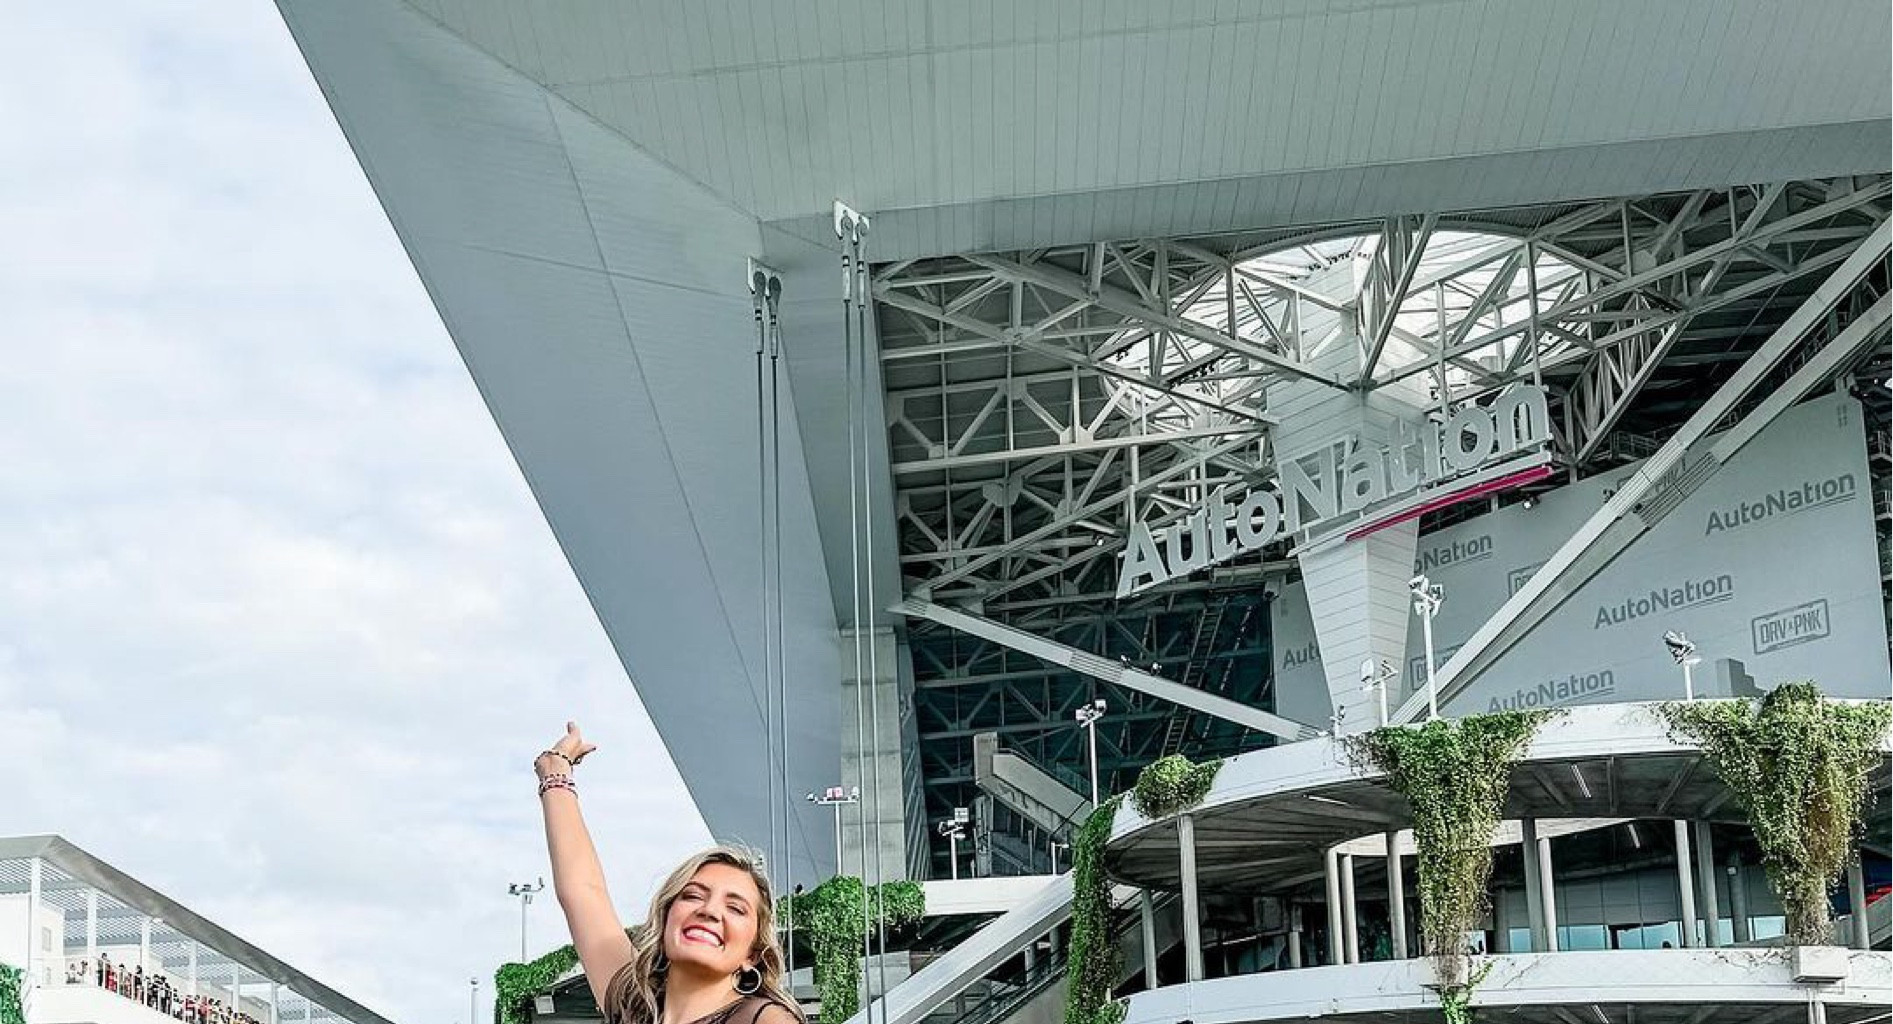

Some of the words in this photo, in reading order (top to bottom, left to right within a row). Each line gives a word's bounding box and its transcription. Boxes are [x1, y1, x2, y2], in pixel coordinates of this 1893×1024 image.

[1117, 383, 1549, 598] AutoNation
[1705, 473, 1855, 536] AutoNation
[1594, 574, 1733, 630] AutoNation
[1488, 669, 1614, 713] AutoNation
